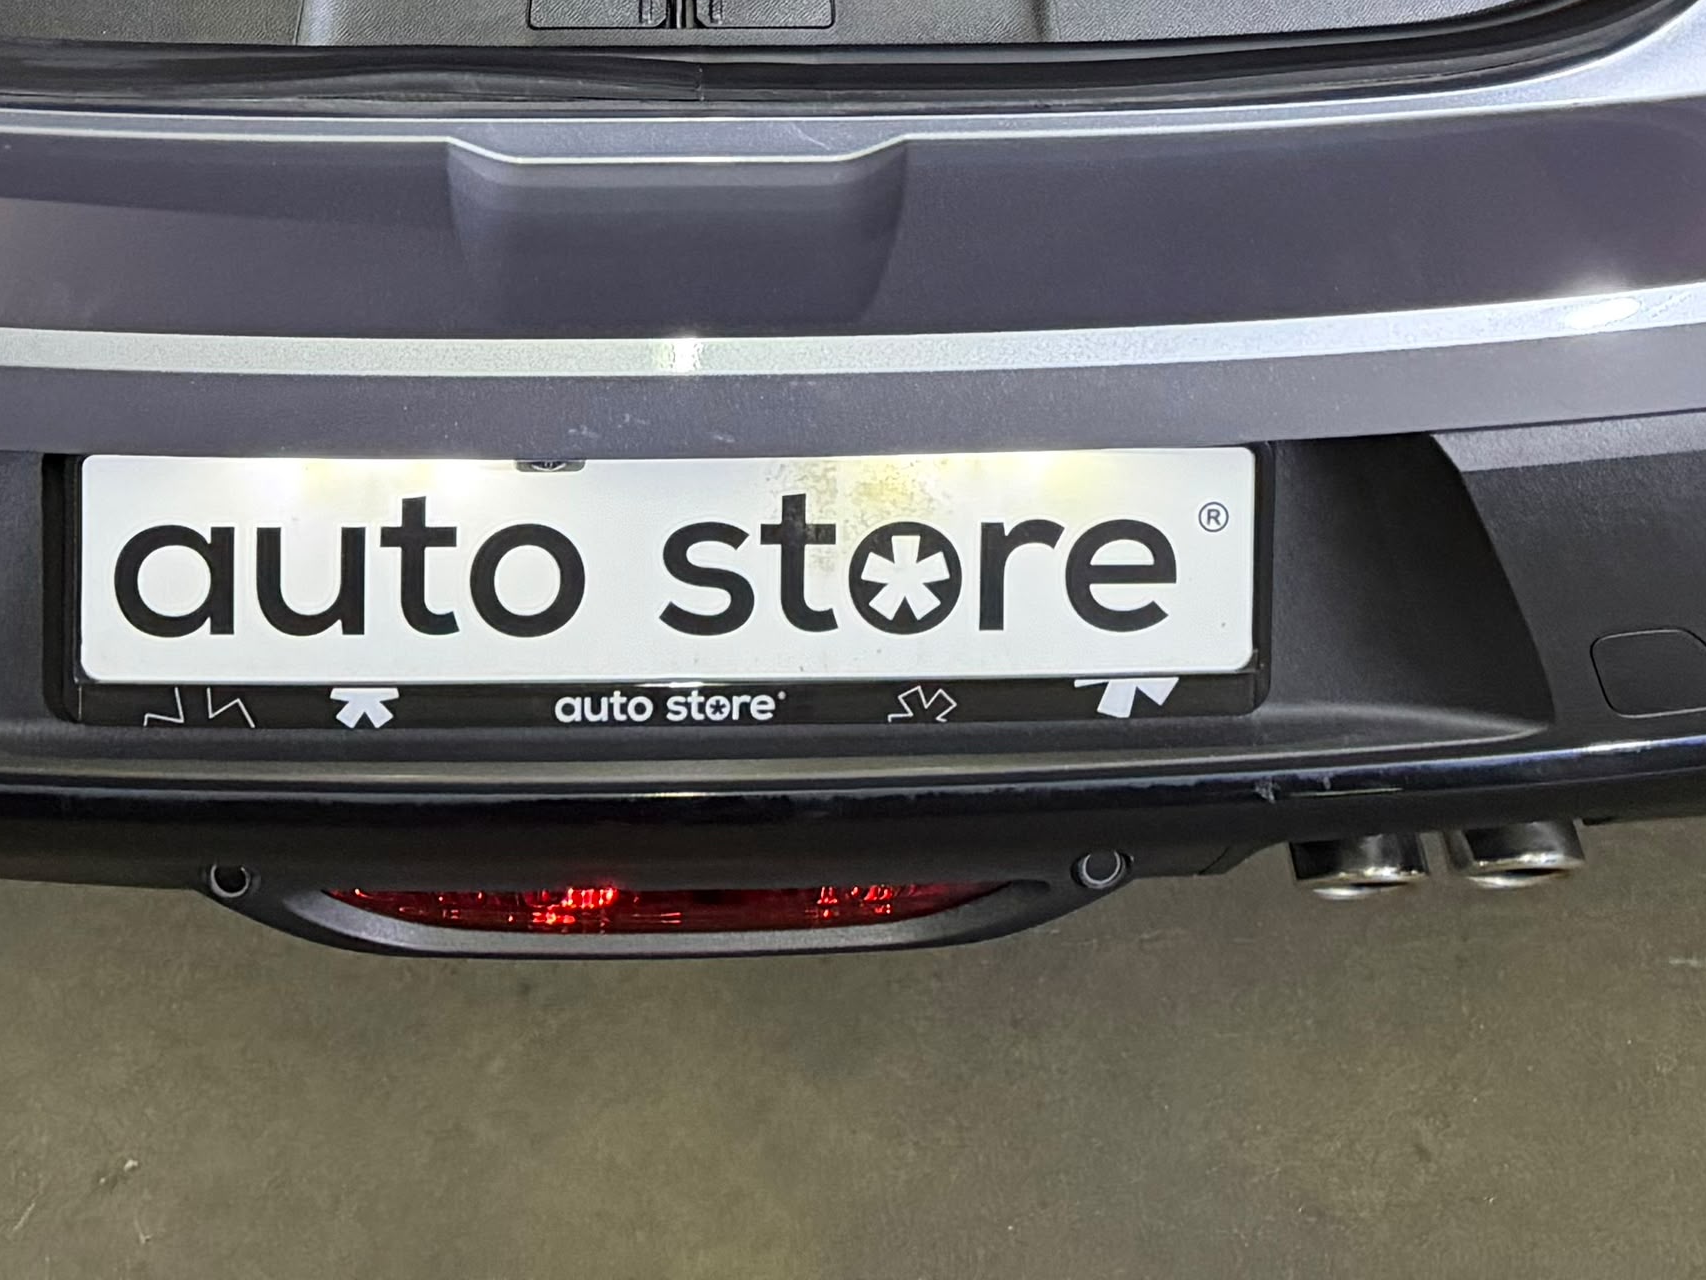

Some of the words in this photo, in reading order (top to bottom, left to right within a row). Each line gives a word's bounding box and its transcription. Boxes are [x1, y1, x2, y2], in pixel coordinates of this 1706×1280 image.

[113, 496, 587, 638] auto
[659, 493, 1178, 636] store
[554, 690, 654, 723] auto
[666, 690, 776, 722] store
